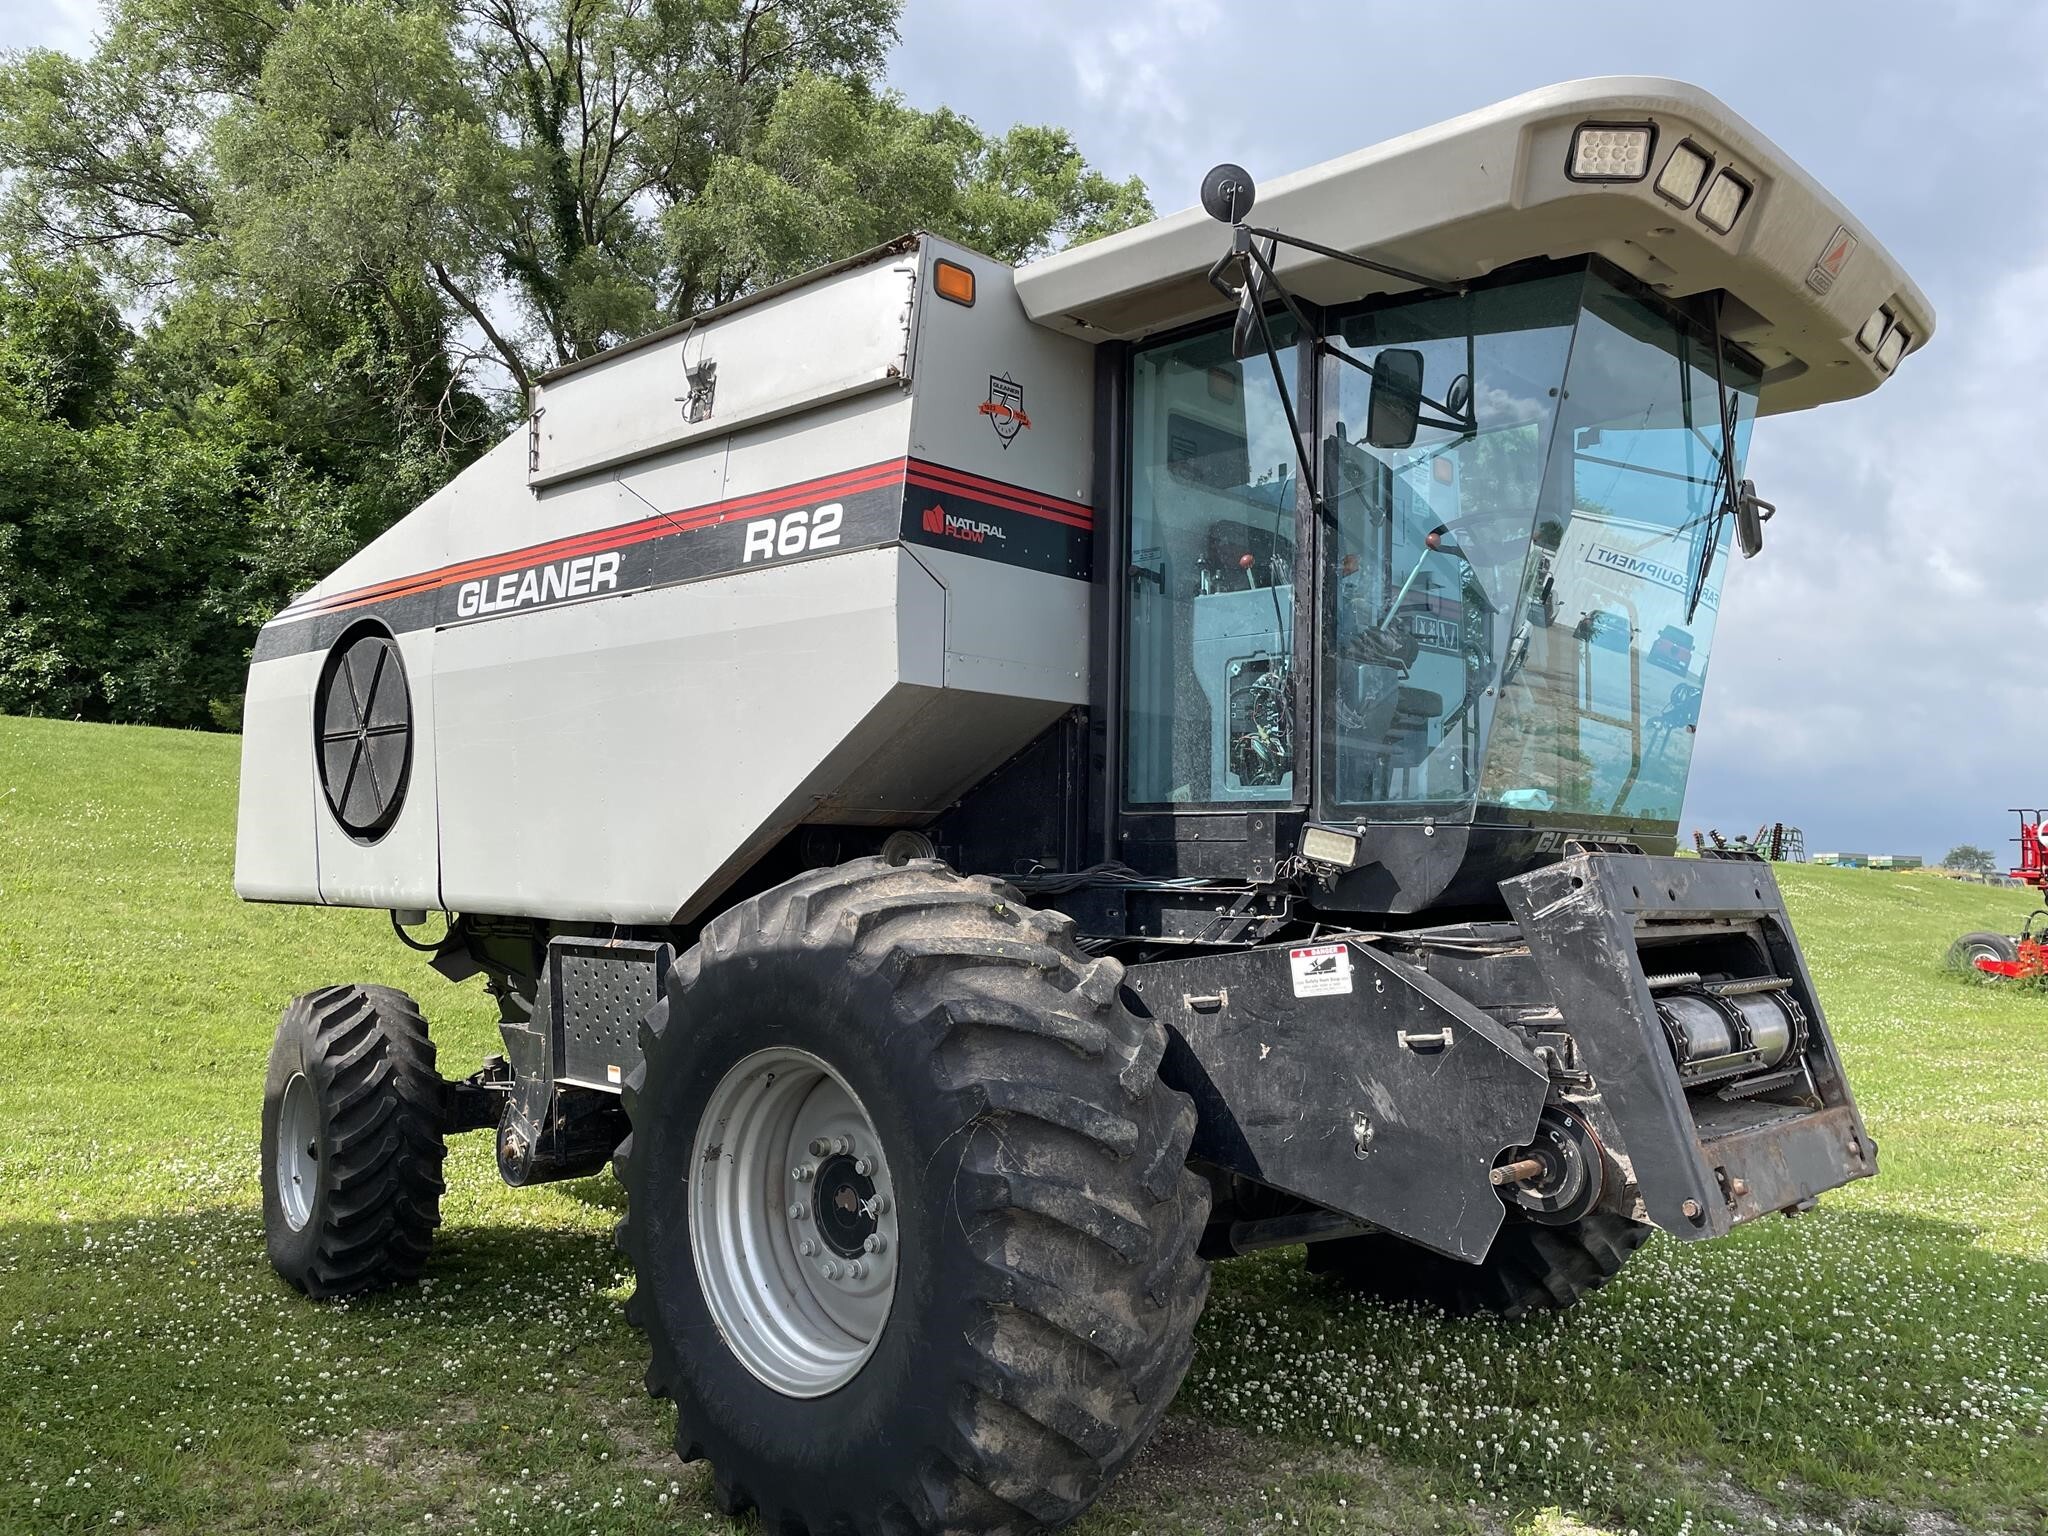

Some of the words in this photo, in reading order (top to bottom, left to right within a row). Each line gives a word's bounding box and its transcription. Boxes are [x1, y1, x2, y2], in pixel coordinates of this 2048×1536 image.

[992, 382, 1020, 395] GLEANER
[742, 503, 844, 563] R62
[945, 514, 1007, 539] NATURAL
[945, 526, 985, 544] FLOW
[456, 551, 621, 617] GLEANER
[1311, 947, 1338, 956] DANGER
